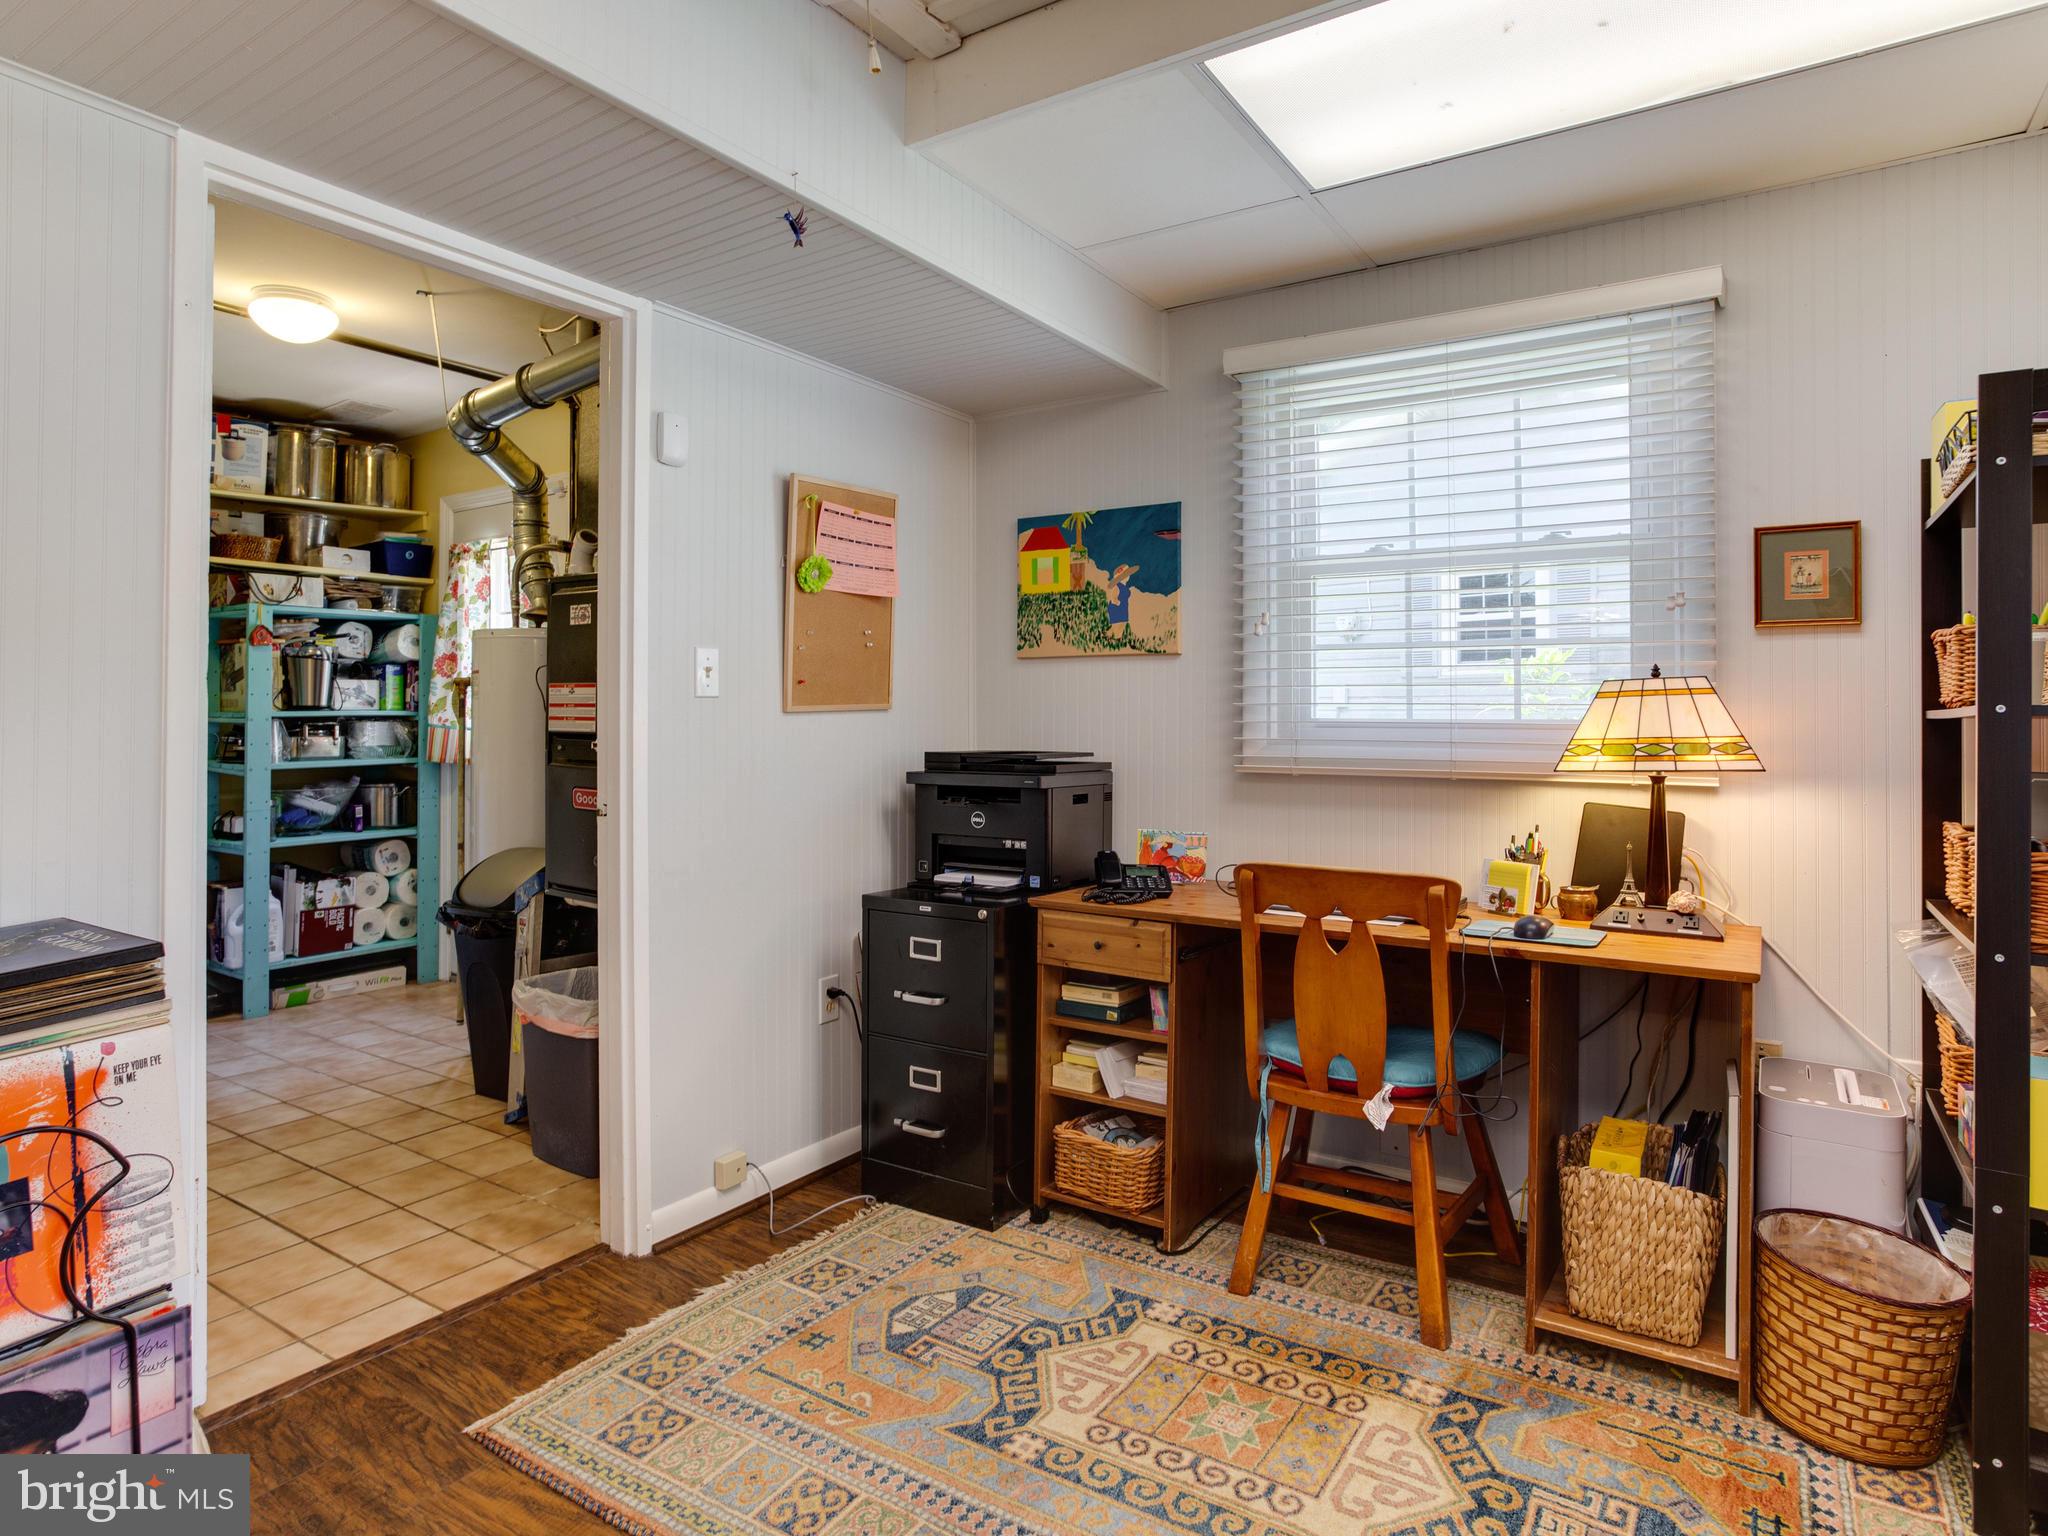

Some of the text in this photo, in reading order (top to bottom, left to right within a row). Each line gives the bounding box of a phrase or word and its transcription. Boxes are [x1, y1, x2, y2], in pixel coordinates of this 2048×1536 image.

[113, 1054, 162, 1075] KEEP YOUR EYE
[113, 1071, 137, 1087] ON ME
